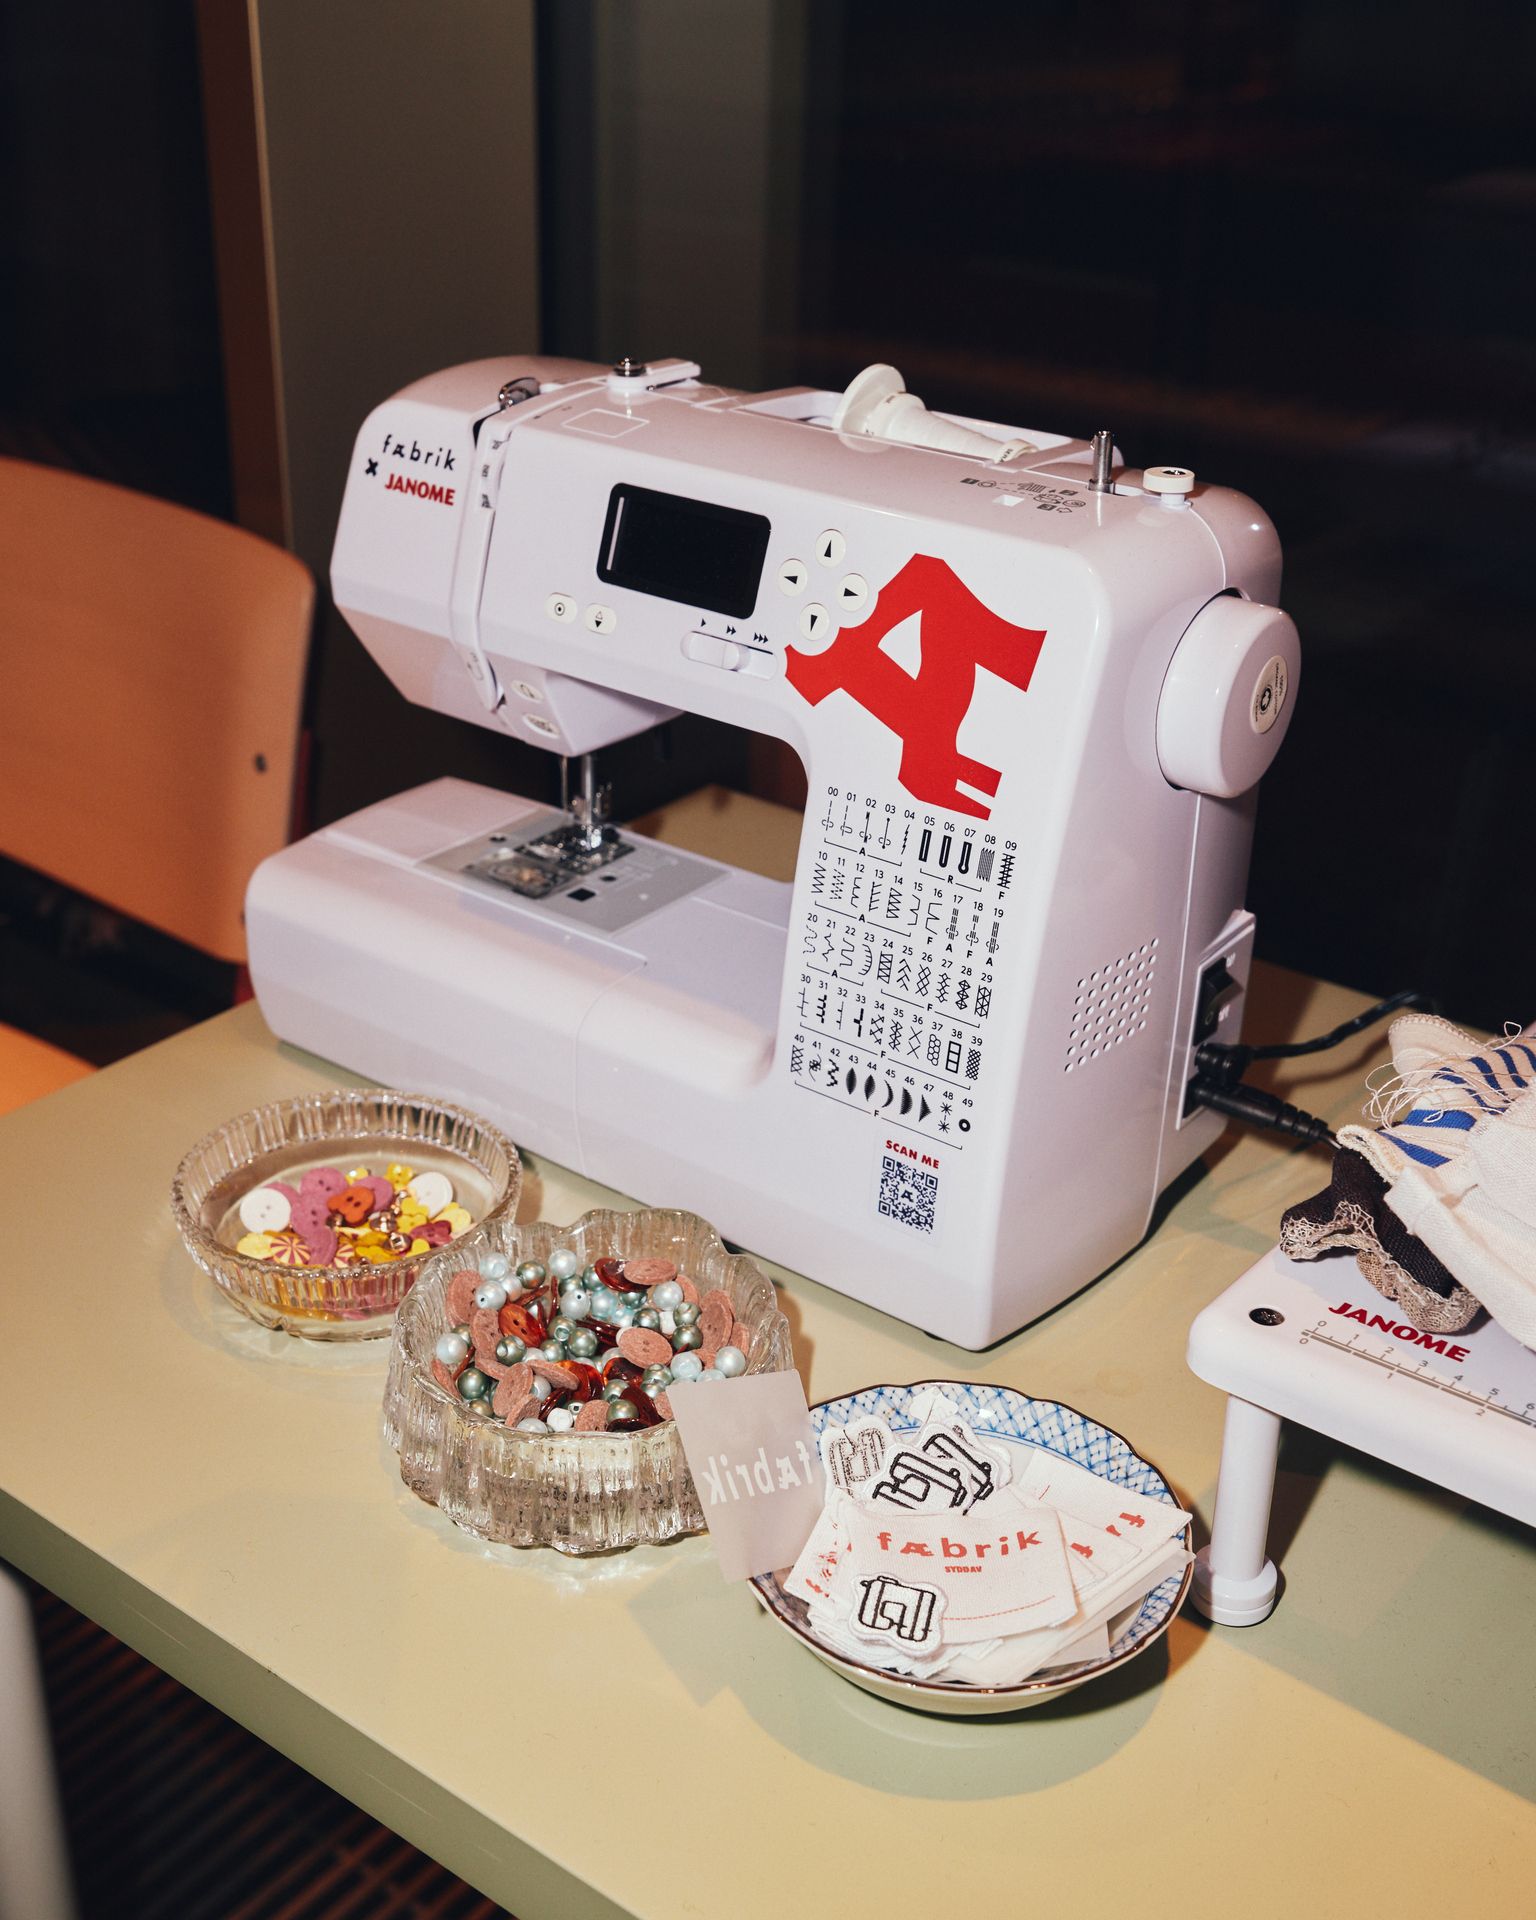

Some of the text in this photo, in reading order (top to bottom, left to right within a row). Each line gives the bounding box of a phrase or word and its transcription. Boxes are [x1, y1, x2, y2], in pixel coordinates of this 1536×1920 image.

[385, 474, 455, 506] JANOME
[827, 786, 1017, 851] 00 01 02 03 04 05 06 07 08 09
[858, 847, 866, 857] A
[818, 851, 1004, 918] 10 11 12 13 14 15 16 17 18 19
[947, 874, 954, 885] R
[998, 891, 1005, 900] F
[858, 913, 866, 923] A
[926, 936, 933, 945] F
[807, 912, 993, 983] 20 21 22 23 24 25 26 27 28 29
[945, 943, 953, 953] A
[966, 949, 973, 959] F
[985, 957, 993, 967] A
[831, 969, 838, 978] A
[800, 973, 983, 1047] 30 31 32 33 34 35 36 37 38 39
[927, 1003, 933, 1012] F
[880, 1050, 887, 1058] F
[794, 1034, 973, 1108] 40 41 42 43 44 45 46 47 48 49
[874, 1109, 880, 1117] F
[886, 1140, 940, 1169] SCAN ME
[1328, 1302, 1471, 1363] JANOME
[1384, 1346, 1394, 1354] 2
[1489, 1388, 1500, 1396] 5
[1475, 1408, 1486, 1417] 2
